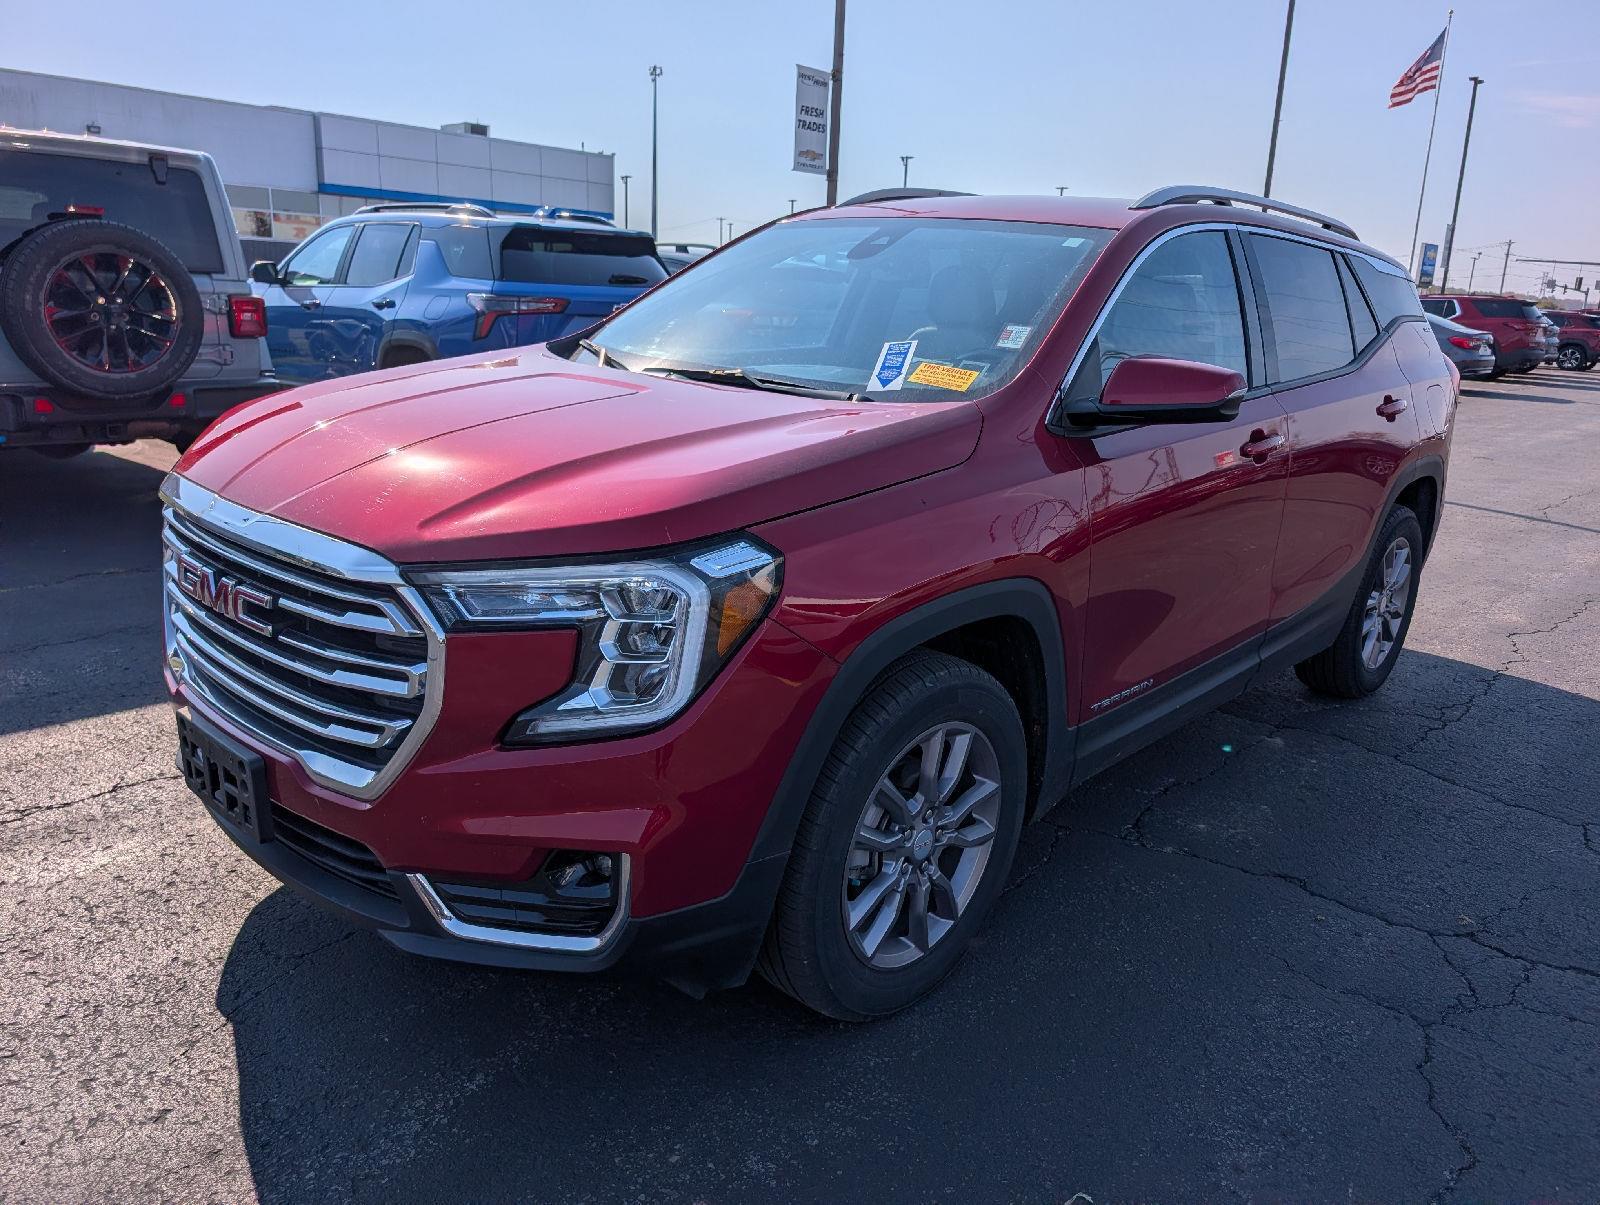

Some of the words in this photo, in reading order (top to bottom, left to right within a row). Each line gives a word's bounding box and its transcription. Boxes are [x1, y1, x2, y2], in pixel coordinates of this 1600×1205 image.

[800, 105, 824, 118] FRESH
[797, 119, 826, 133] TRADES
[923, 363, 940, 371] THIS
[178, 554, 272, 638] GMC
[1091, 679, 1153, 711] TERRAIN
